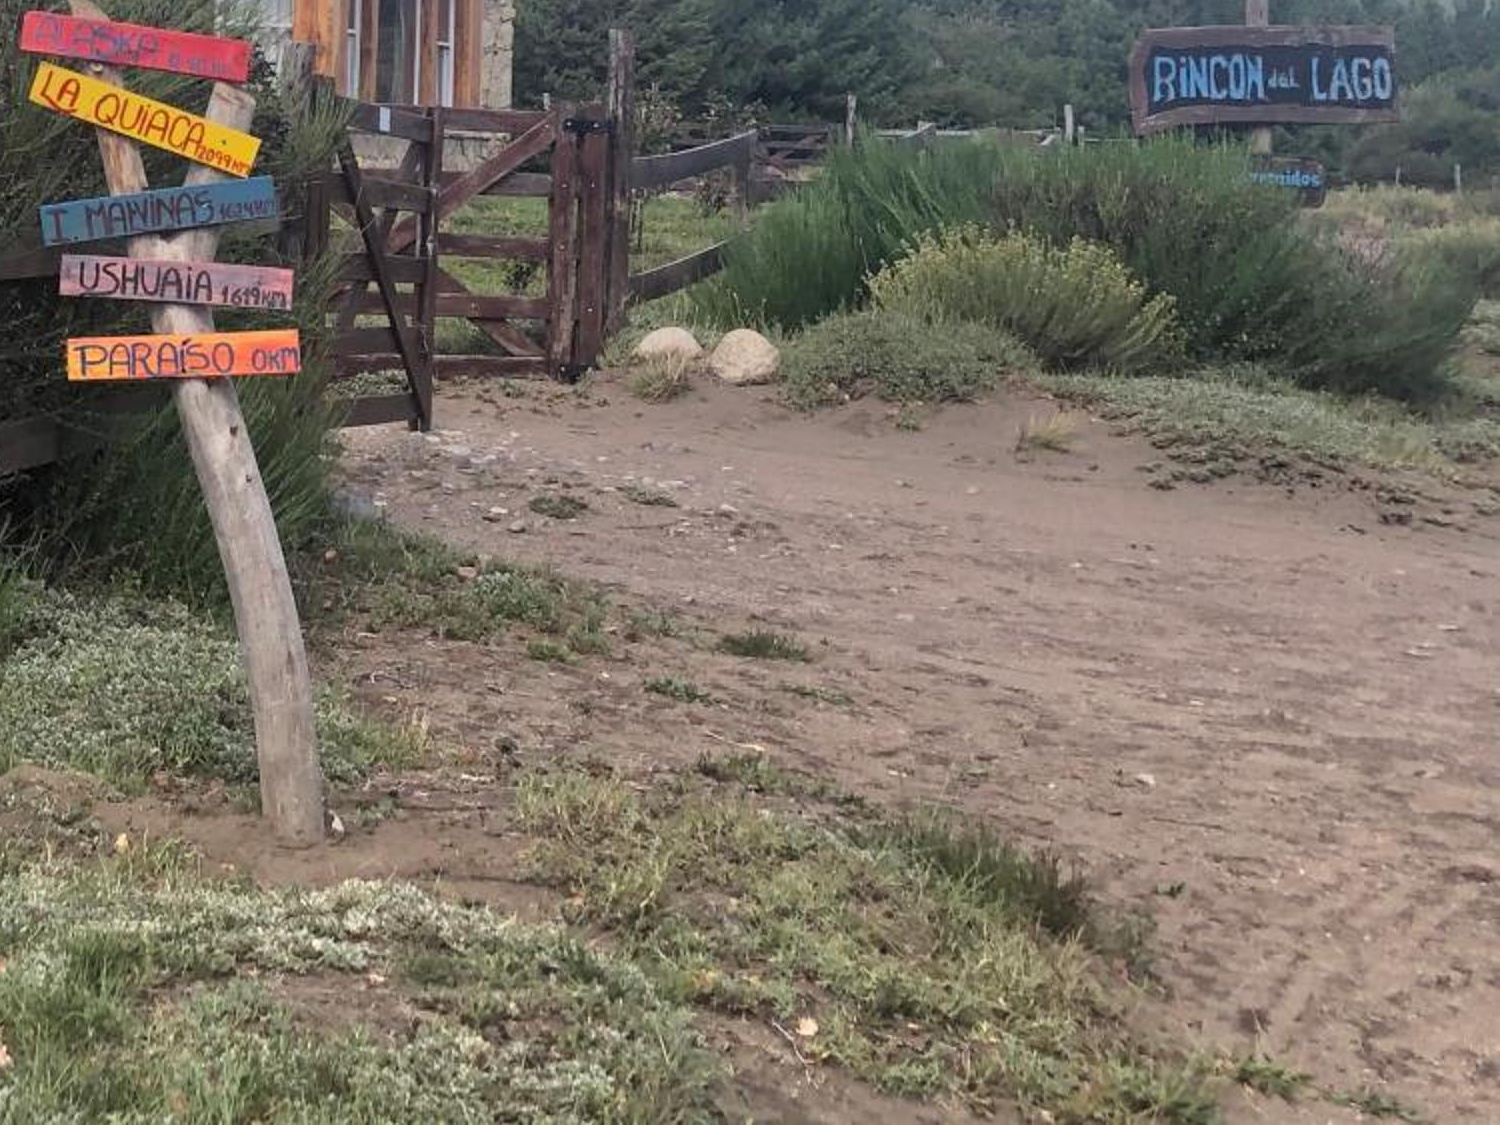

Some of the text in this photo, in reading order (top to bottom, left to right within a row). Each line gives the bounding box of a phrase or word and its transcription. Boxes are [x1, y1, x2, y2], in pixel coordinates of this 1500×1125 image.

[40, 70, 81, 113] LA
[1311, 56, 1392, 101] LAGO
[85, 190, 214, 236] MALVINAS
